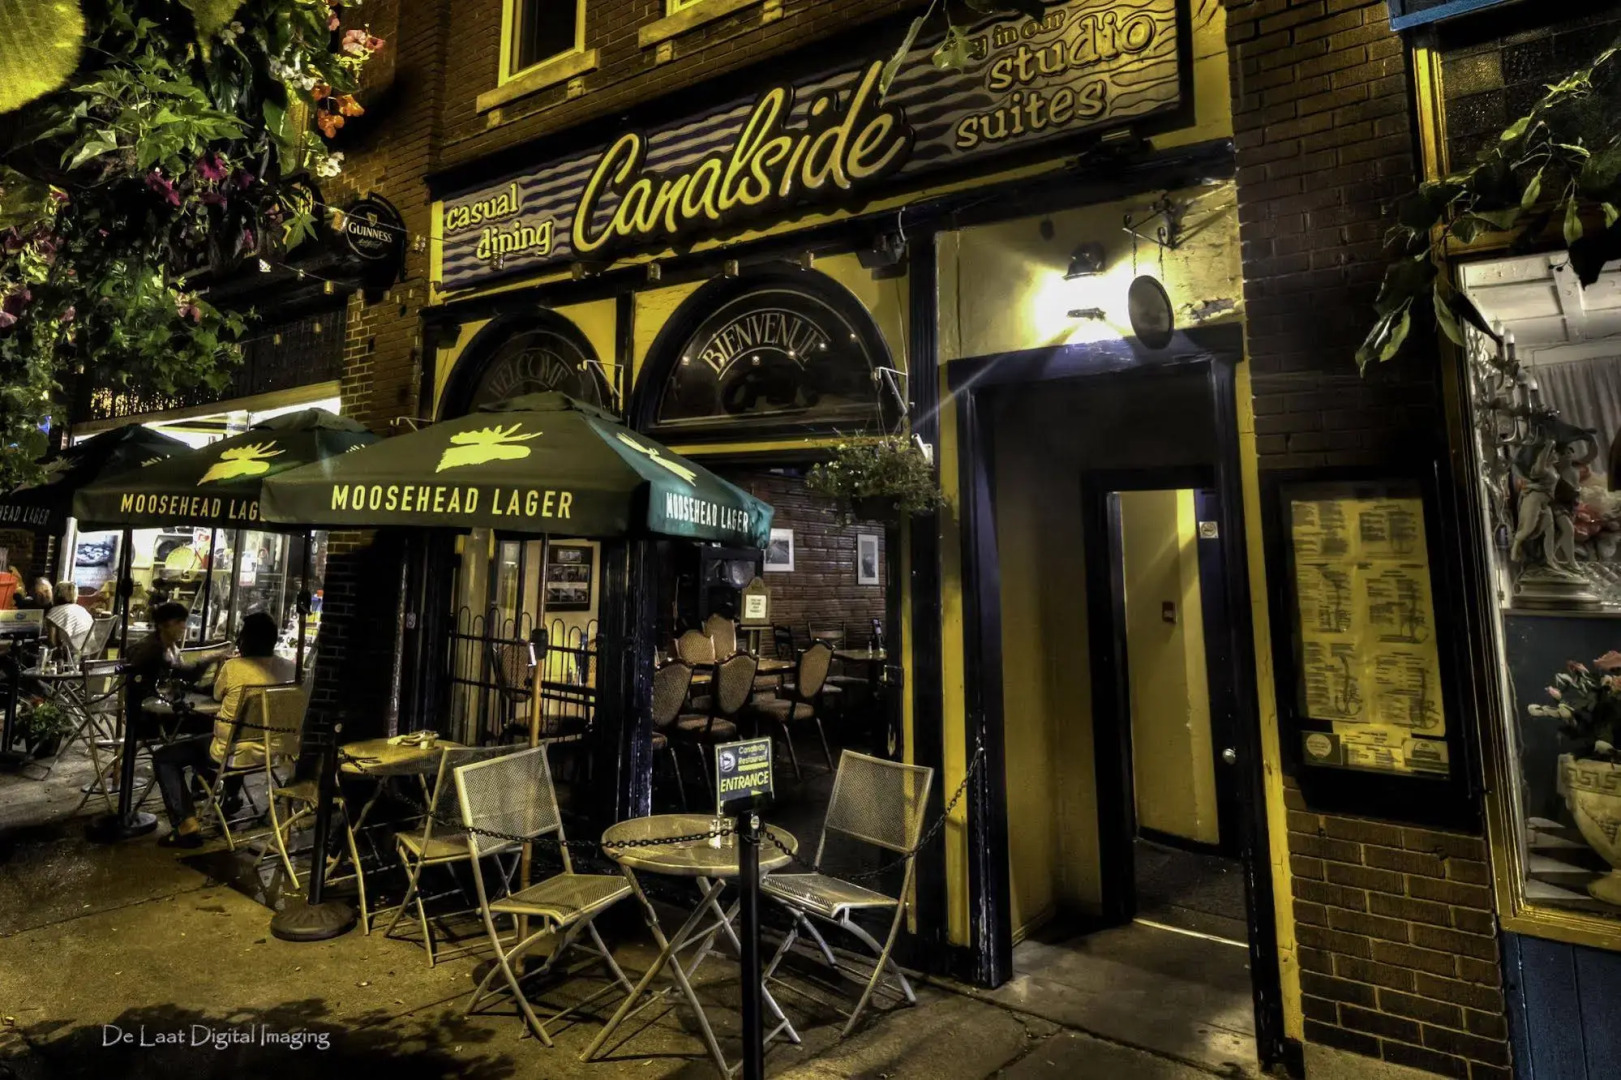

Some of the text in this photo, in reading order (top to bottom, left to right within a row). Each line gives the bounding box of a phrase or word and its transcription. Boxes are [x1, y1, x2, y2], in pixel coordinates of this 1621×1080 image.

[990, 13, 1155, 89] studio
[996, 26, 1017, 47] in
[956, 80, 1105, 148] suites
[572, 59, 906, 252] Canalside
[446, 182, 518, 230] casual
[348, 222, 393, 243] GUINNESS
[476, 220, 553, 260] dining
[702, 312, 824, 375] BIENVENUE
[488, 352, 569, 398] WELCOME
[22, 506, 51, 527] LAGER
[120, 493, 266, 522] MOOSEHEAD LAG
[331, 484, 573, 519] MOOSEHEAD LAGER
[666, 492, 749, 533] MOOSEHEAD LAGER
[720, 771, 769, 793] ENTRANCE
